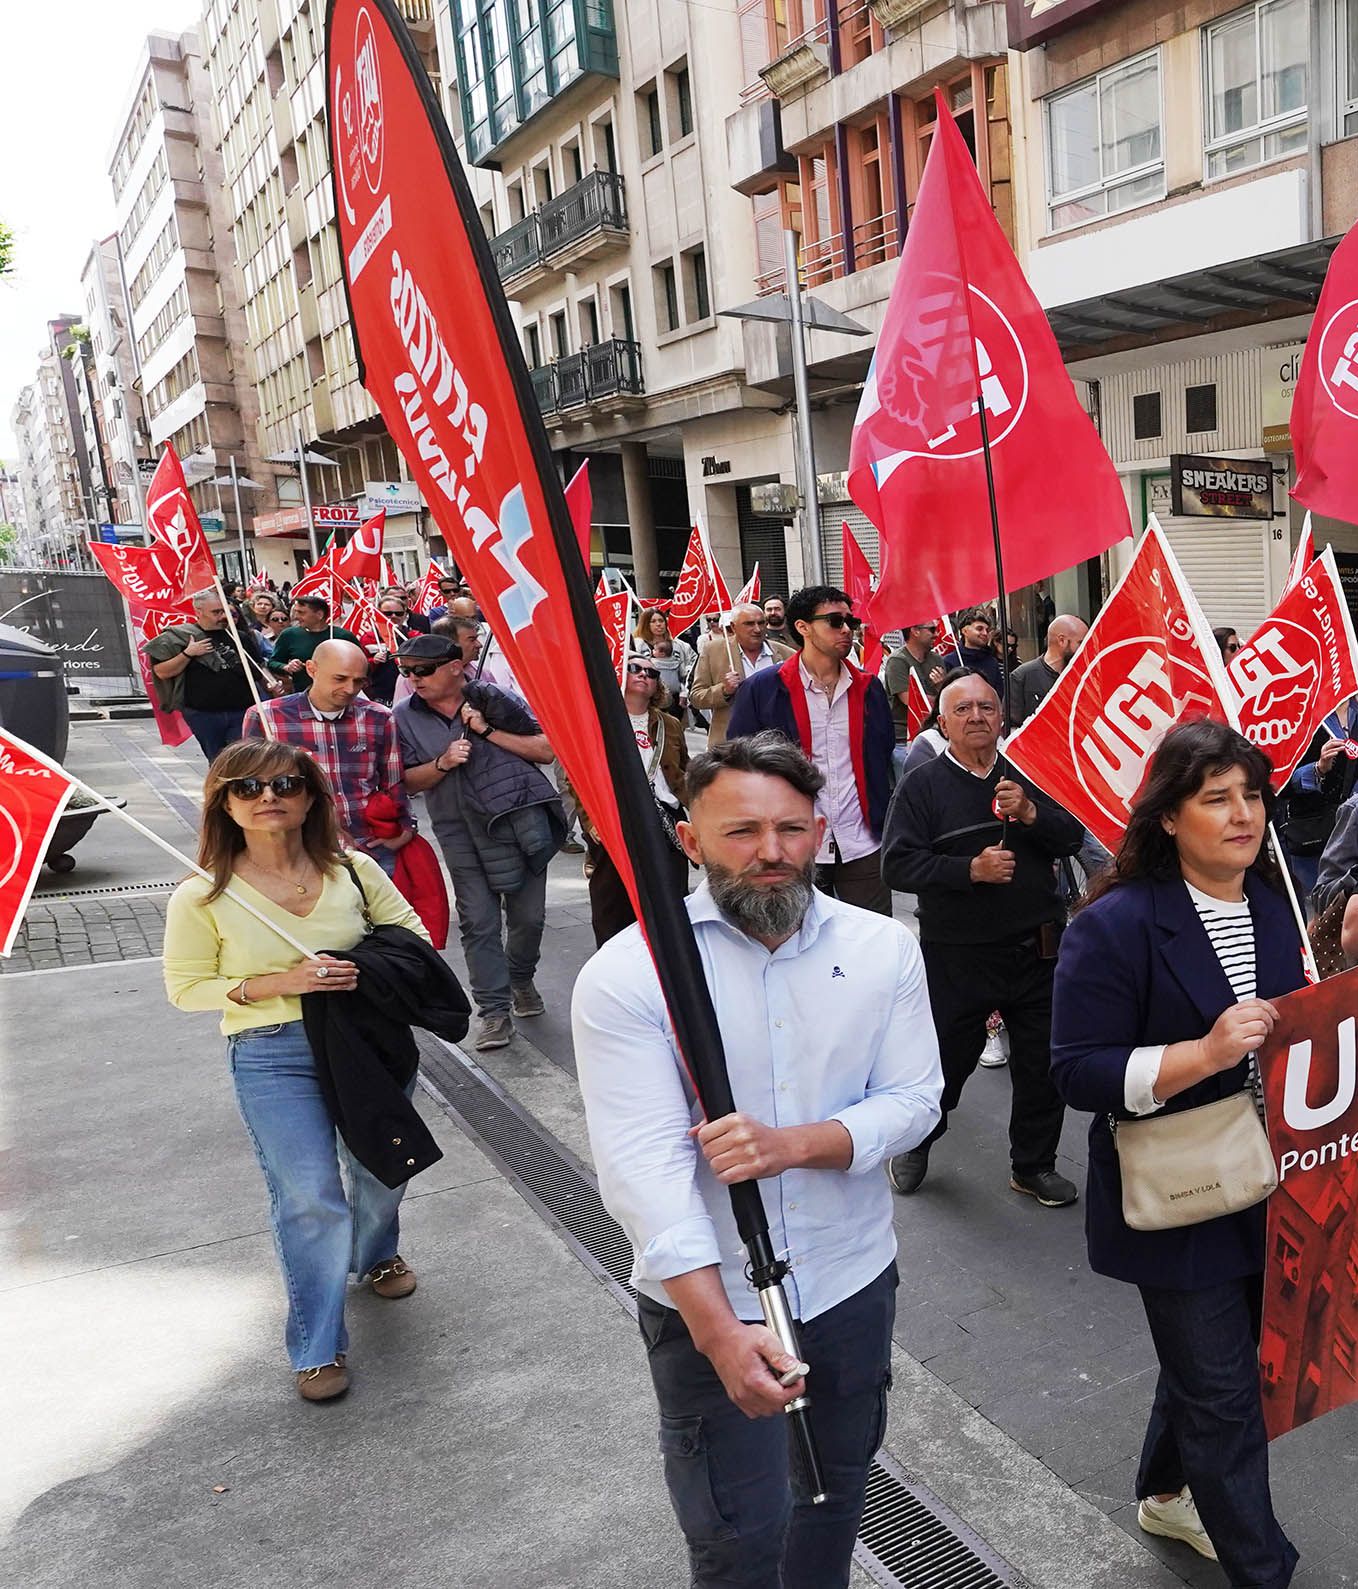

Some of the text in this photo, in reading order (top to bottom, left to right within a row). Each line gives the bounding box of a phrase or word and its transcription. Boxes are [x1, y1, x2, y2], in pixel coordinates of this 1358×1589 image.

[1182, 469, 1268, 493] SNEAKERS
[1200, 491, 1252, 506] STREET
[312, 507, 361, 522] FROIZ
[1273, 529, 1283, 540] 16
[1300, 576, 1342, 696] www.UGT.es
[1227, 627, 1304, 705] GT
[1081, 648, 1180, 798] UGT
[1201, 1182, 1222, 1193] LOLA
